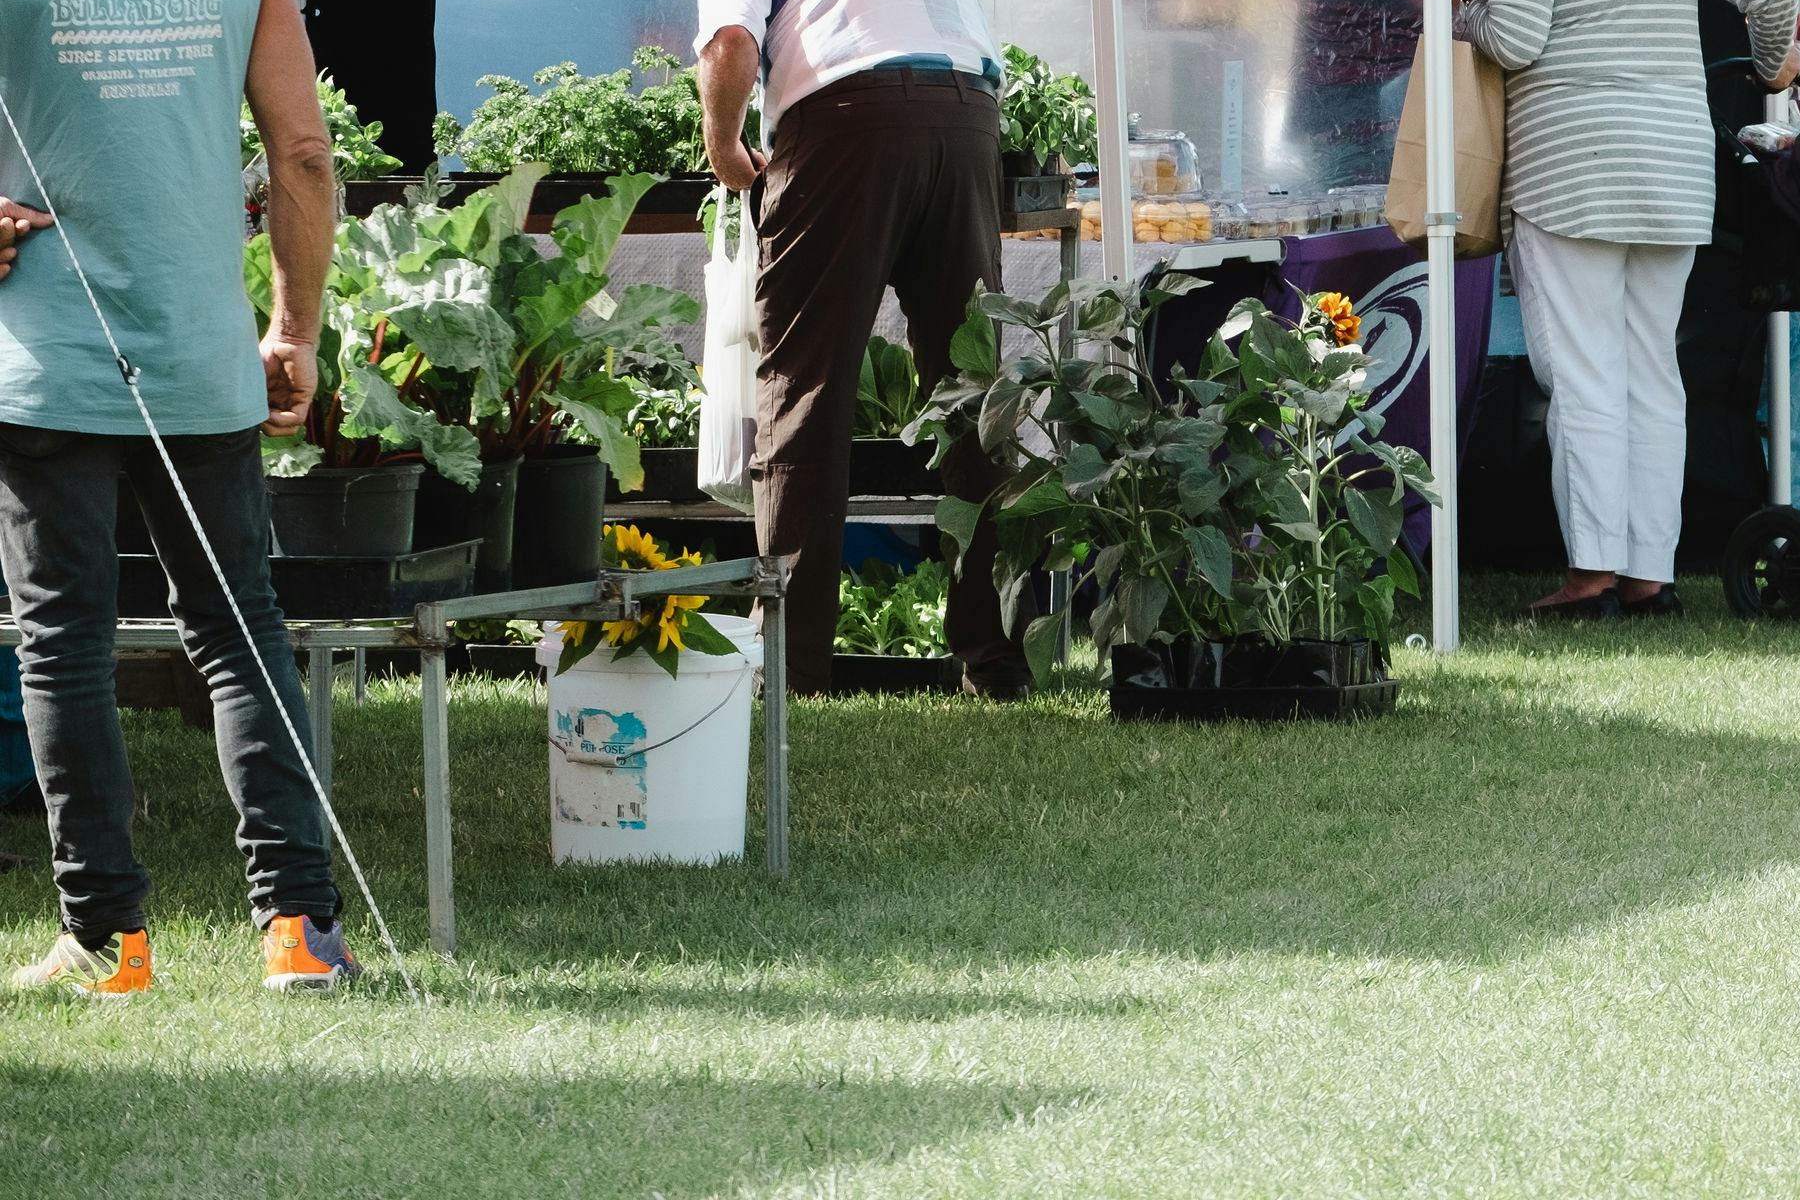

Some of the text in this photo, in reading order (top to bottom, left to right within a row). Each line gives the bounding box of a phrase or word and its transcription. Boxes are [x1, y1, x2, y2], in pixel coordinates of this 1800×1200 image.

[57, 43, 215, 64] SINCE SEVENTY THREE
